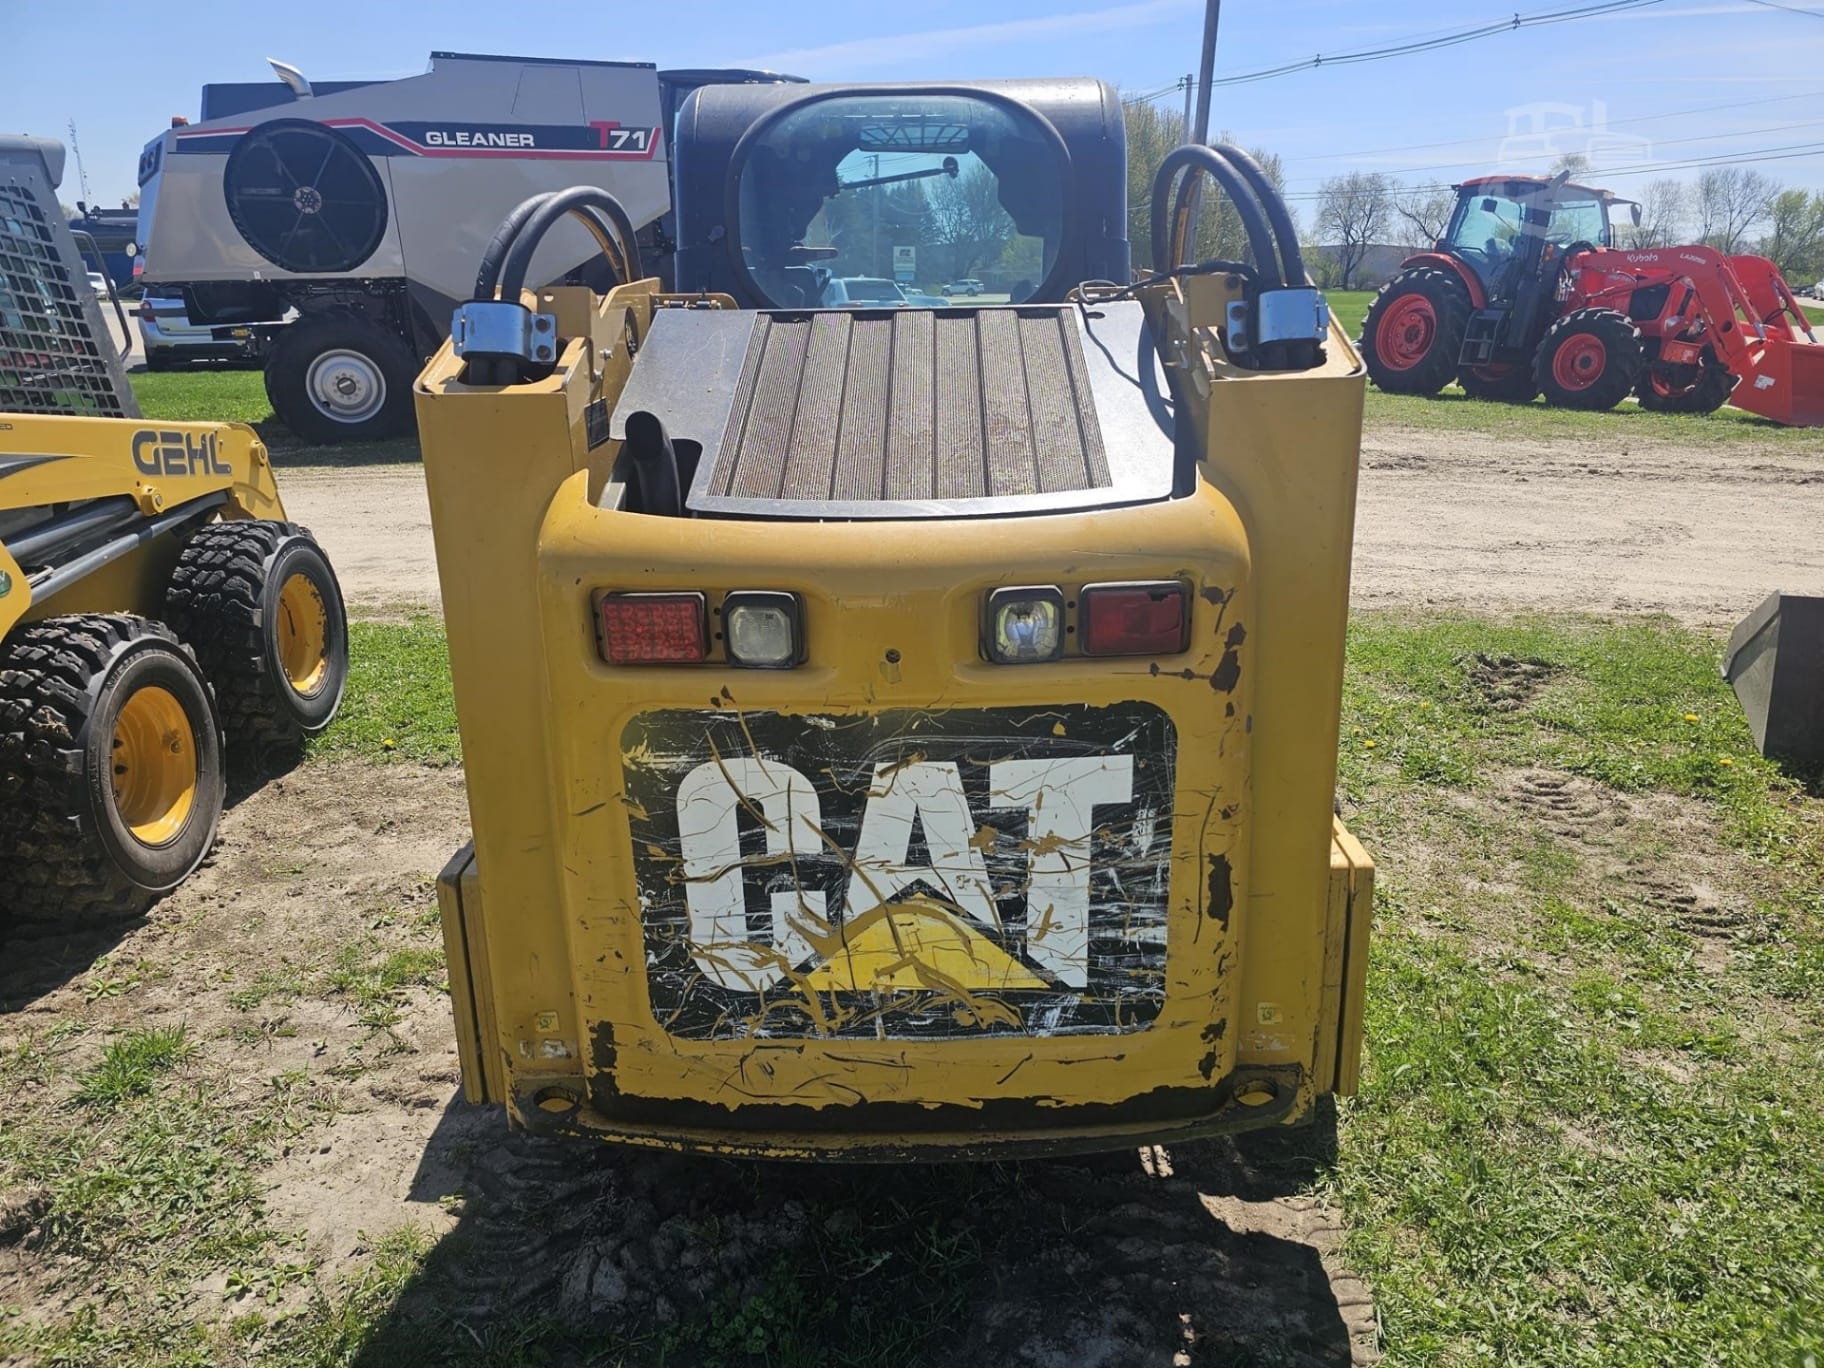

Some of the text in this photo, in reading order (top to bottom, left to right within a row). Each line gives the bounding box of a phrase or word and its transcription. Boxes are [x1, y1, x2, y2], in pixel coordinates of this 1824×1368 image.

[425, 121, 645, 149] GLEANER T71
[1626, 252, 1659, 263] Kubota
[131, 430, 232, 475] GEHL
[676, 754, 1134, 992] CAT
